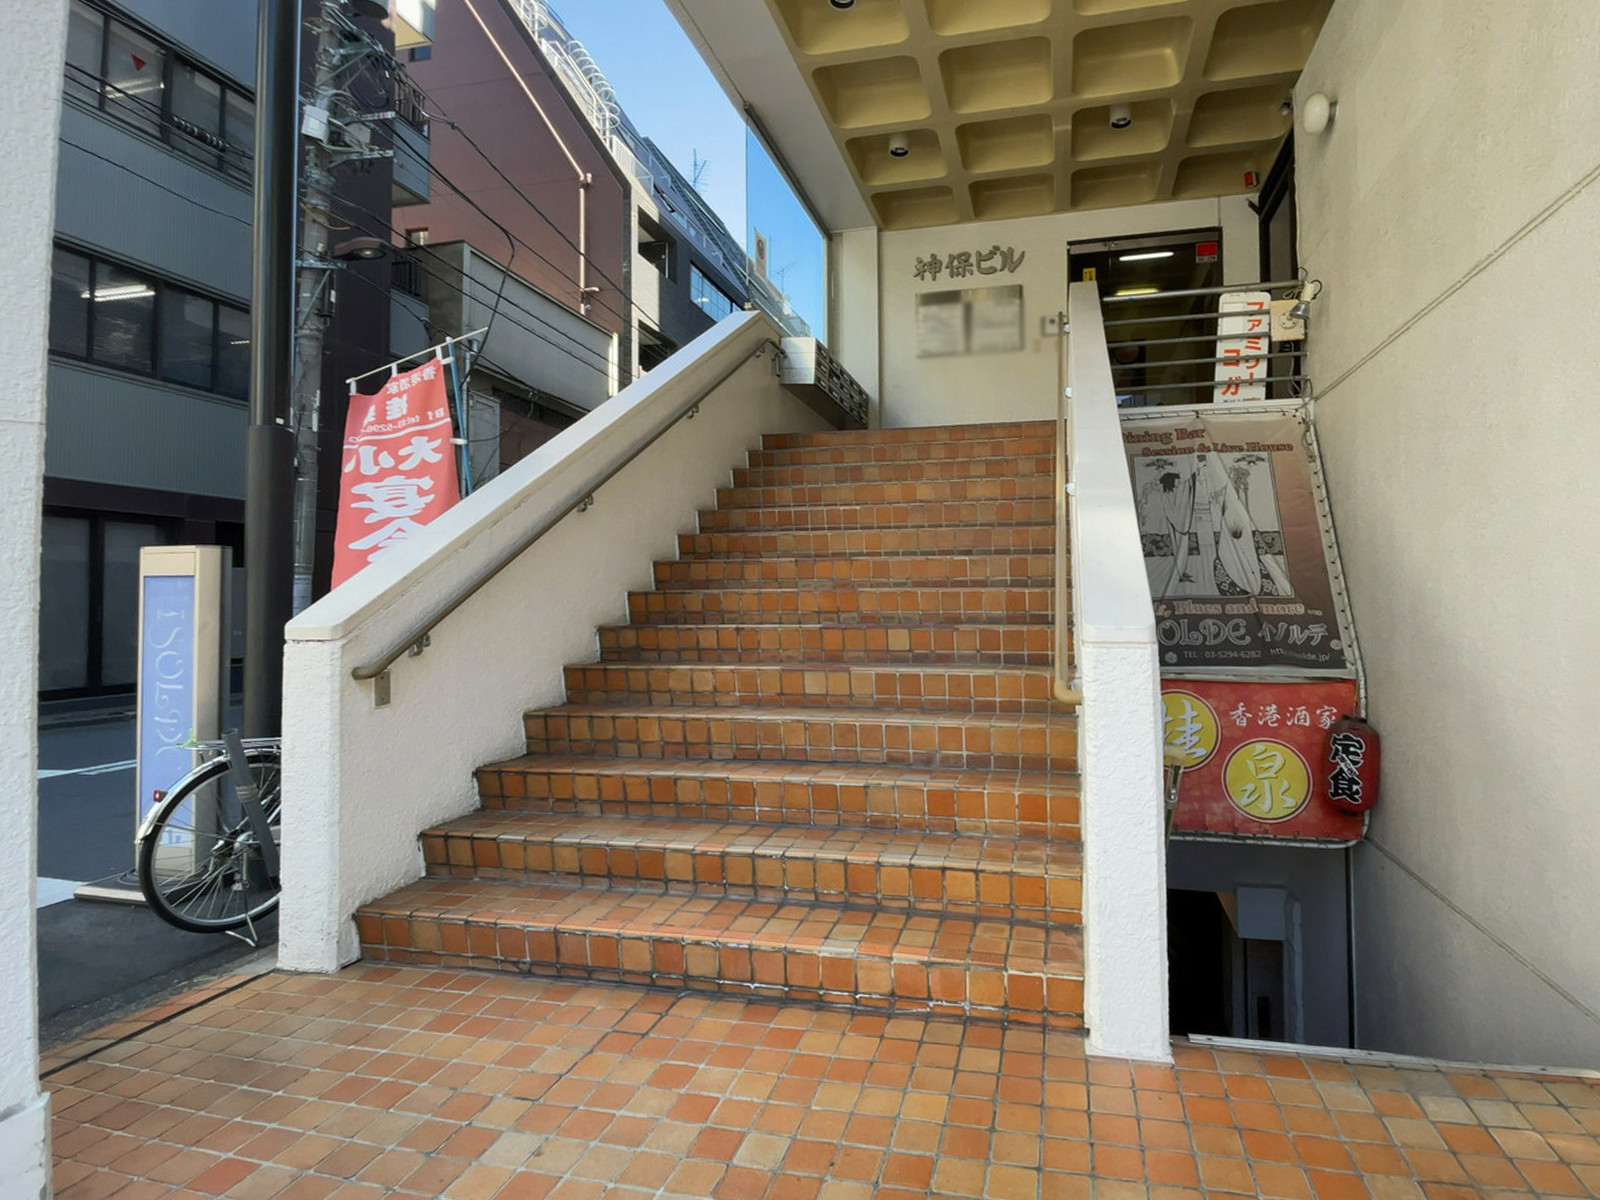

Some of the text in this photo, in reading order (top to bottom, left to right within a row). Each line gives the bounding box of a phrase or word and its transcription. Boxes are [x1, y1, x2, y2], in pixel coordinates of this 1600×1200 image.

[913, 245, 1026, 281] 神保ビル
[1221, 348, 1242, 395] コガ
[1174, 428, 1206, 441] Bar
[1246, 441, 1294, 453] House
[1173, 599, 1222, 615] Blues
[1224, 598, 1258, 615] and
[1259, 602, 1305, 615] more
[1157, 618, 1251, 646] OLDE
[1229, 701, 1338, 730] 香港酒家
[1240, 743, 1298, 813] 泉
[1328, 732, 1366, 805] 定食
